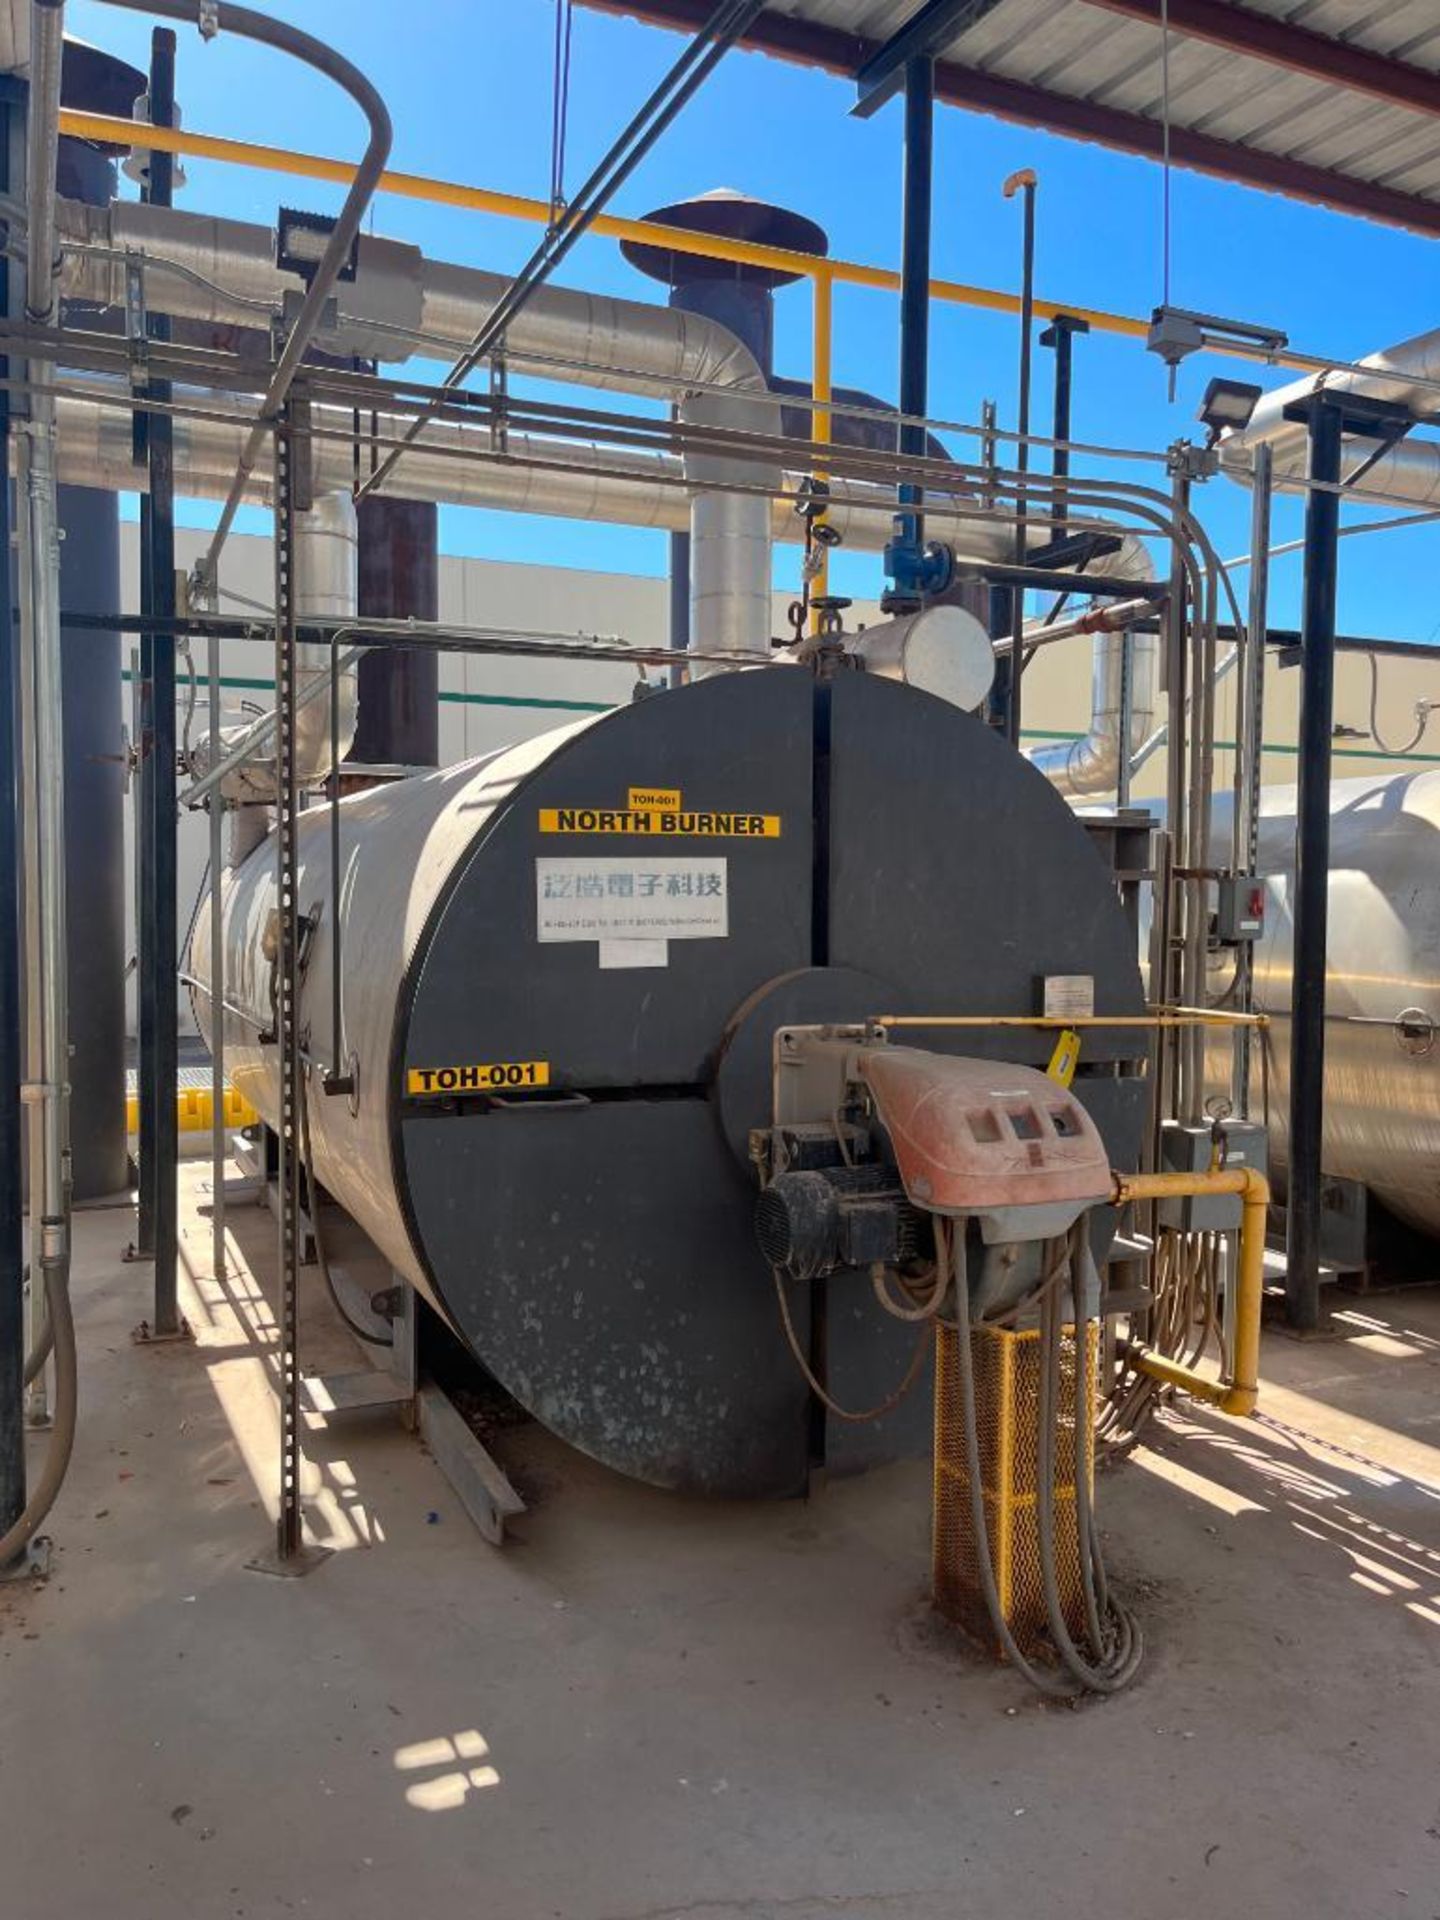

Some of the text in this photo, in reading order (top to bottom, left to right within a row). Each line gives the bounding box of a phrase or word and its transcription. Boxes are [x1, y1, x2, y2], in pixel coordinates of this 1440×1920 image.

[632, 795, 676, 805] TOH-001
[558, 811, 765, 834] NORTH BURNER
[418, 1064, 535, 1090] TOH-001
